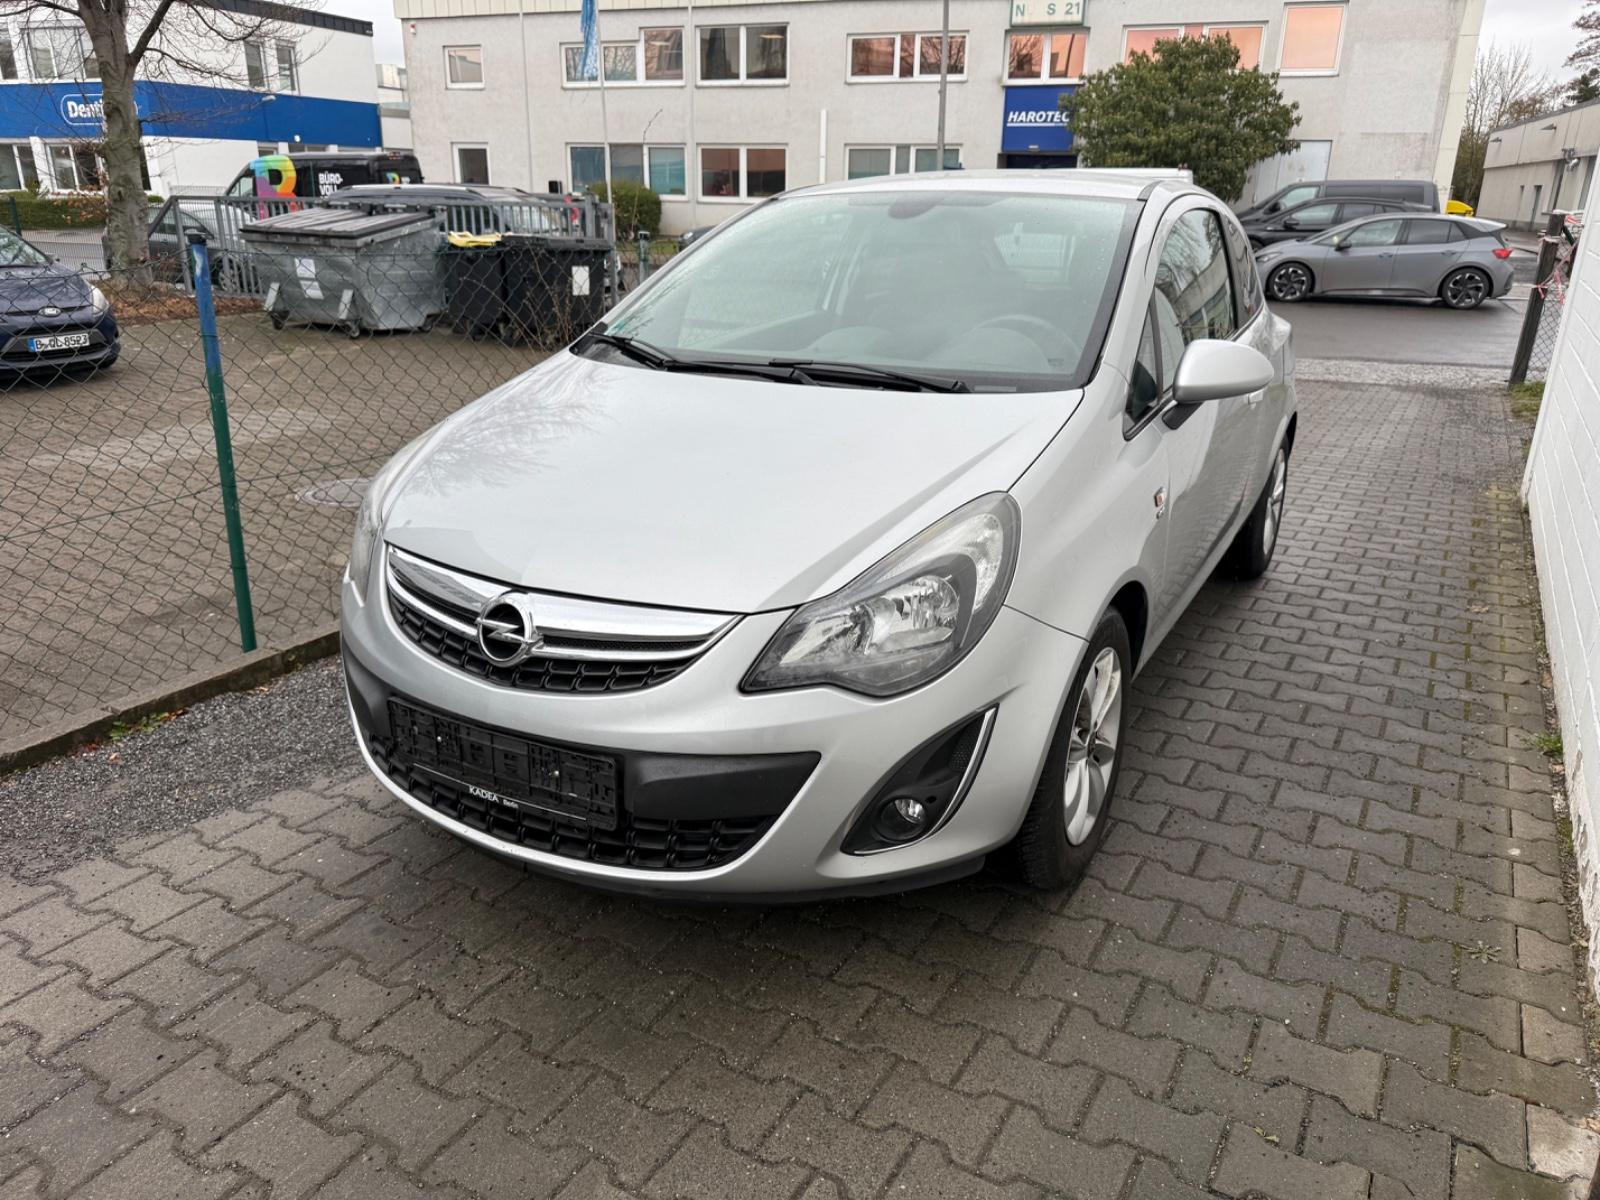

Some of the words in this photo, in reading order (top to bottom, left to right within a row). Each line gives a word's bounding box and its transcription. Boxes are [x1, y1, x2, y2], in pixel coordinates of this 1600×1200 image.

[1016, 4, 1025, 16] N
[1047, 3, 1056, 15] S
[1065, 2, 1080, 15] 21
[1007, 111, 1070, 122] HAROTEC
